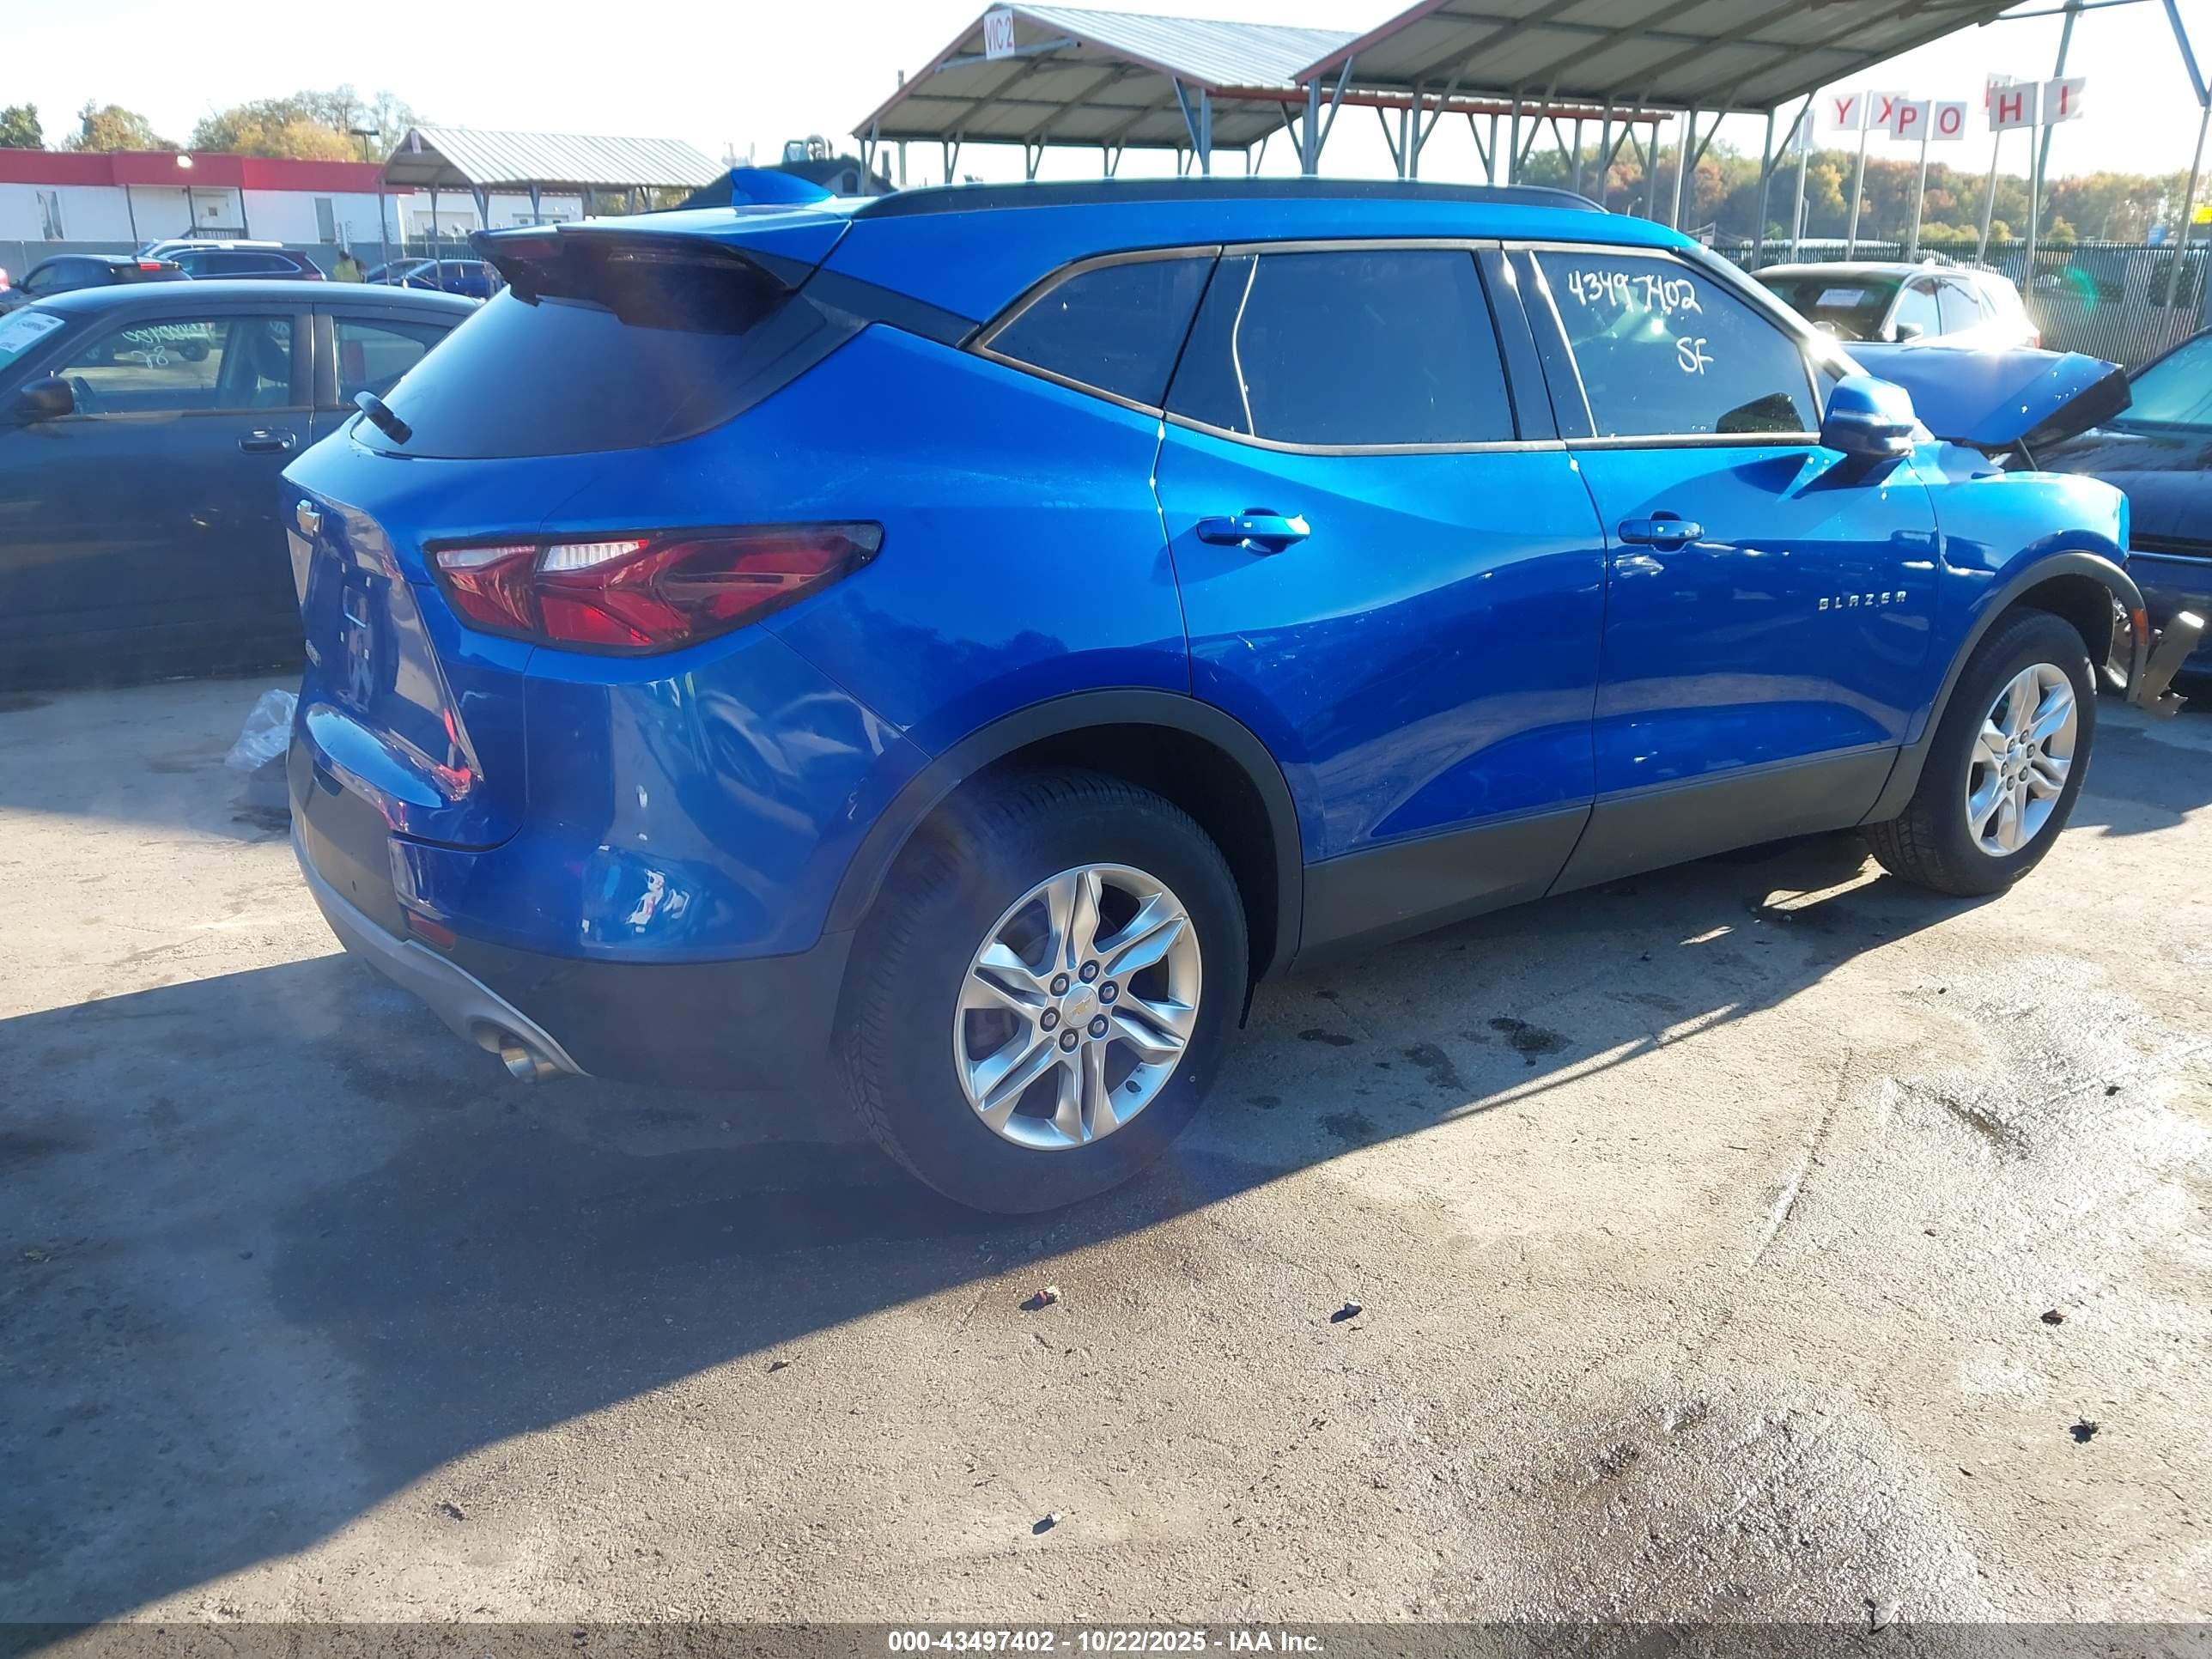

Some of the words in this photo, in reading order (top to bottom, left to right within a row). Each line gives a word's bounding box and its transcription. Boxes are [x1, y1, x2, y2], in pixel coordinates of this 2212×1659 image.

[985, 17, 1003, 52] VIC
[1006, 16, 1012, 49] 2
[1834, 97, 1854, 124] Y
[1899, 106, 1917, 134] P
[1940, 106, 1961, 134] O
[1999, 92, 2022, 123] H
[1676, 337, 1714, 375] SF
[1818, 590, 1907, 611] BLAZER
